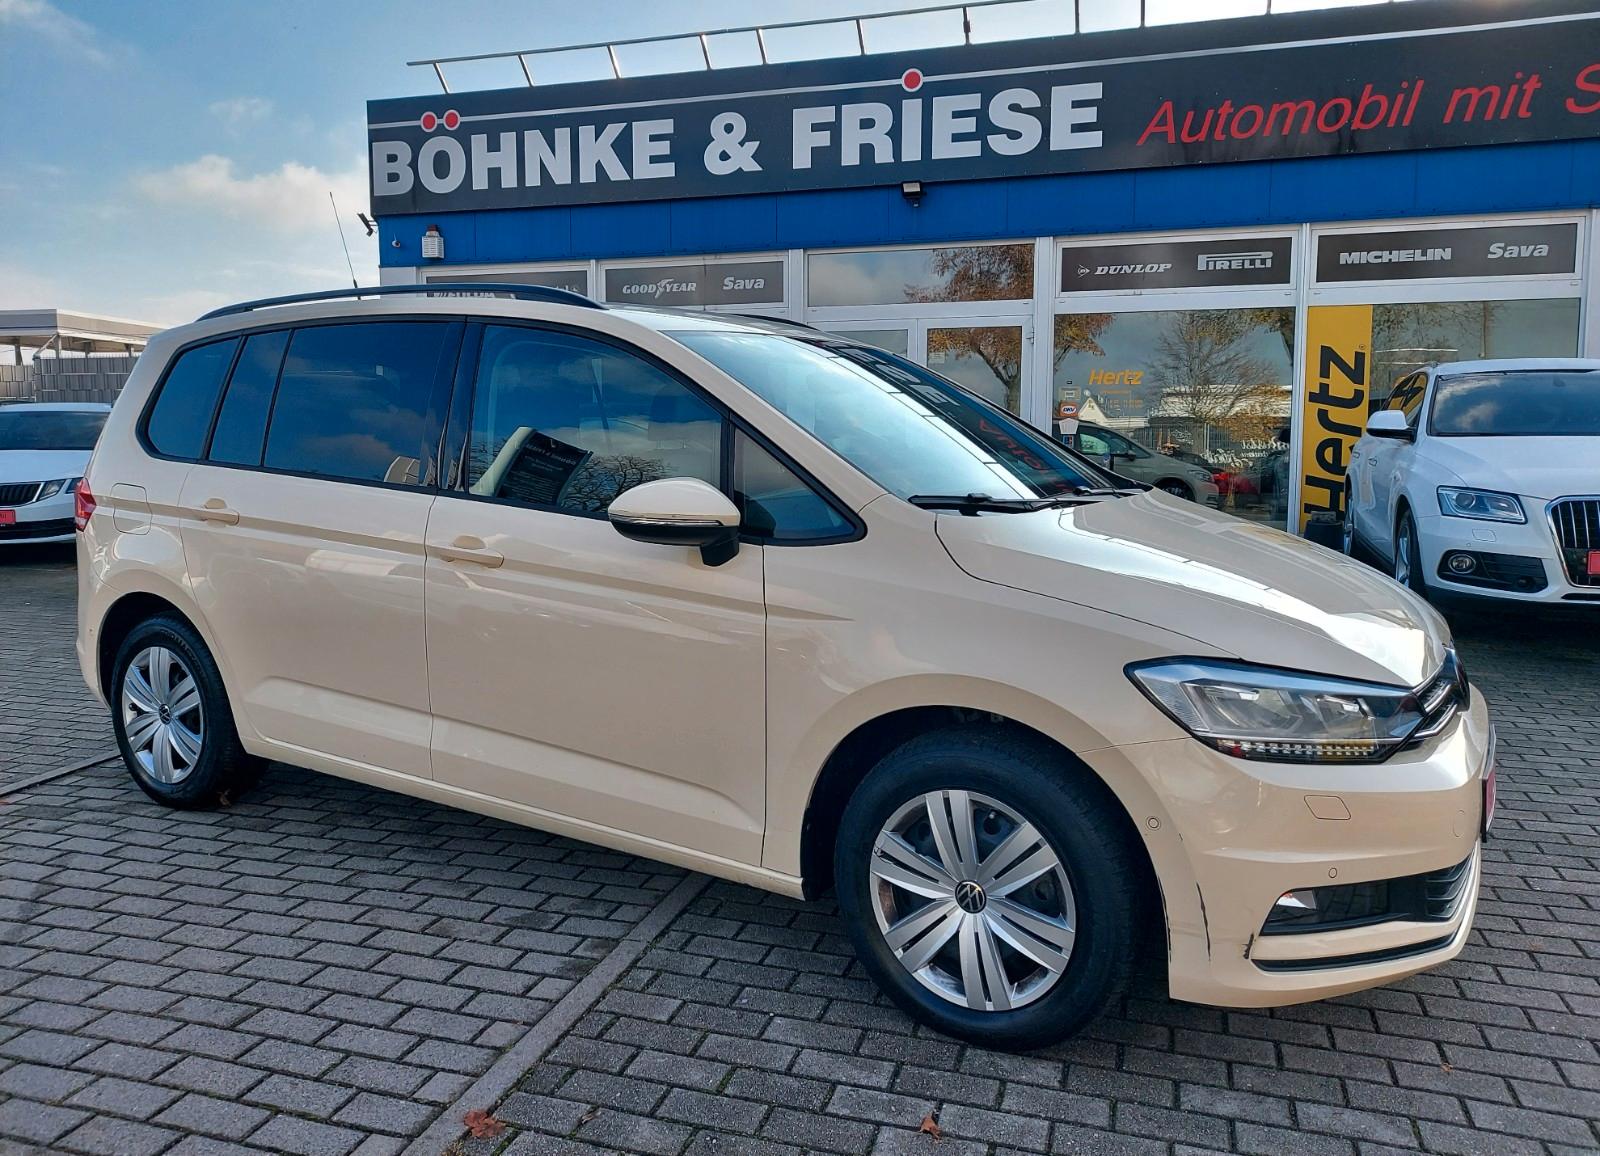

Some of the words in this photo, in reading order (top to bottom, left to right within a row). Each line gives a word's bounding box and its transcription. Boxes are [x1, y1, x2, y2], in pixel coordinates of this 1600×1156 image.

[1136, 79, 1425, 146] Automobil
[1443, 71, 1541, 124] mit
[371, 110, 676, 197] BÖHNKE
[703, 111, 763, 176] &
[1339, 247, 1452, 265] MICHELIN
[1487, 242, 1549, 259] Sava
[1094, 263, 1172, 275] DUNLOP
[1197, 251, 1273, 271] PIRELLI
[622, 280, 697, 296] GOODYEAR
[723, 276, 765, 290] Sava
[1088, 368, 1144, 385] Hertz
[1303, 344, 1366, 522] Hertz
